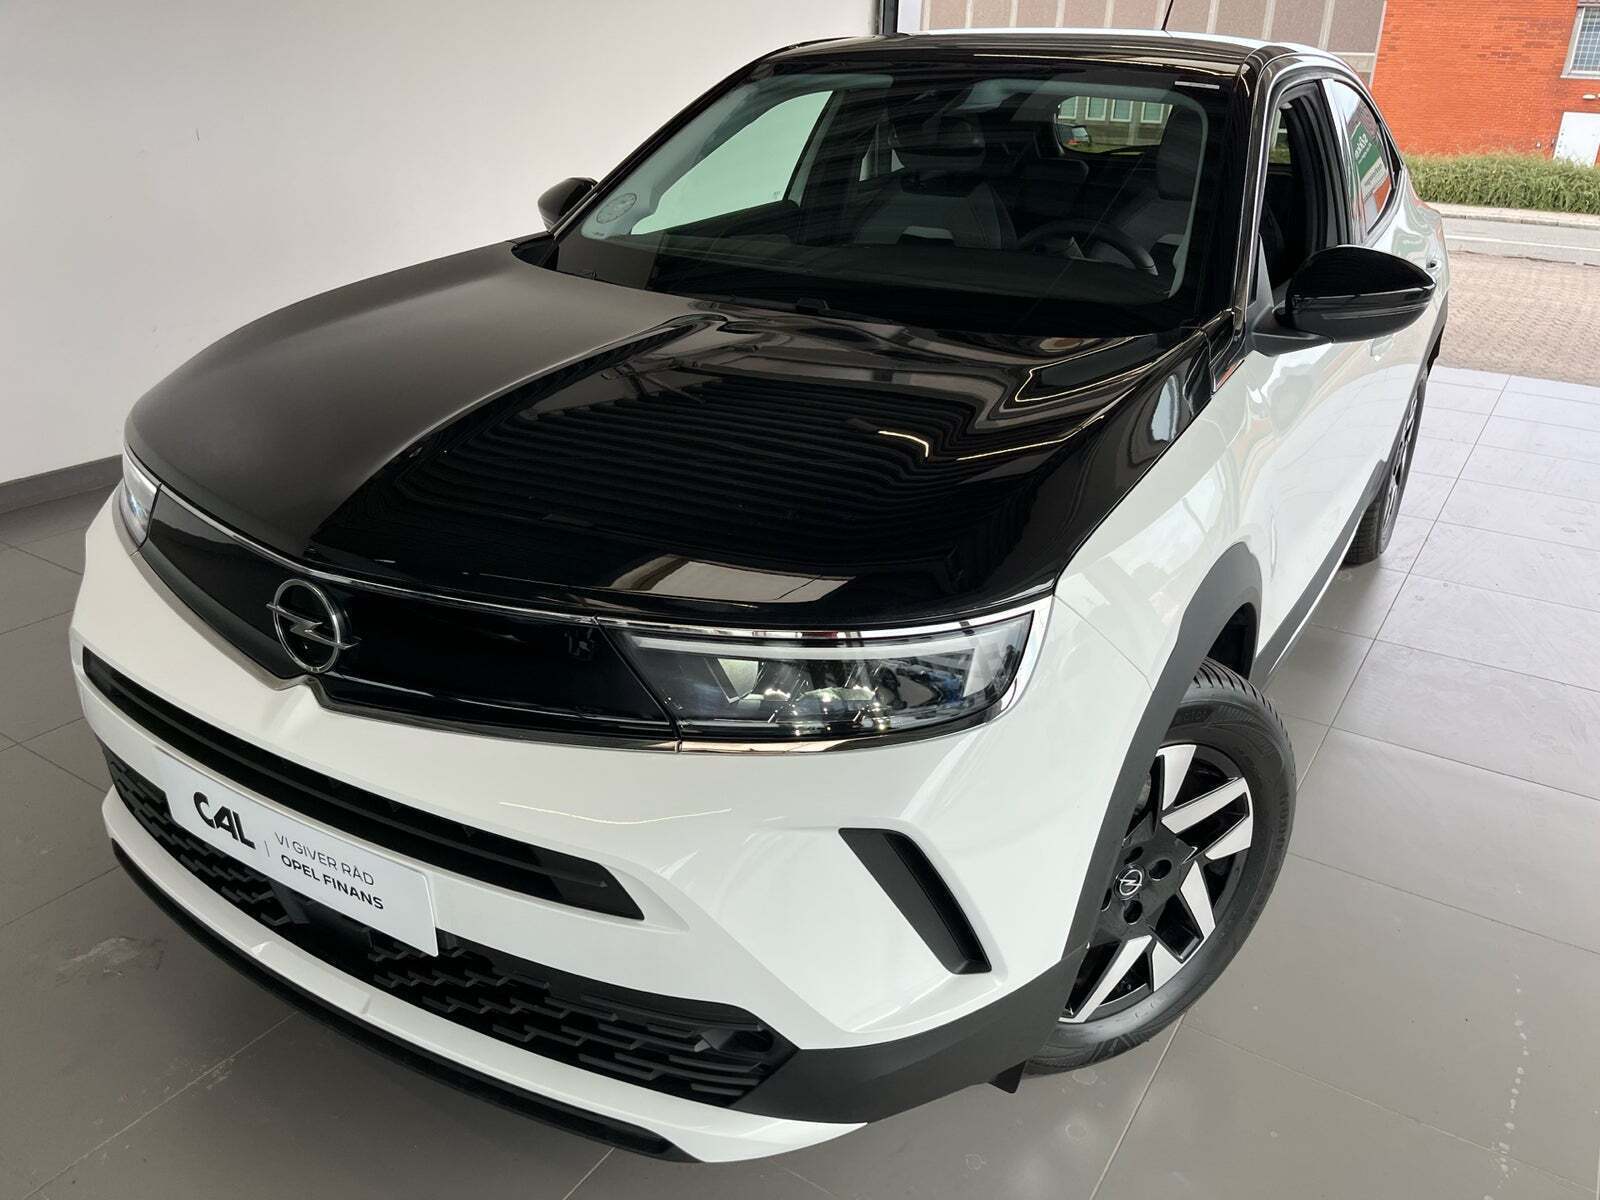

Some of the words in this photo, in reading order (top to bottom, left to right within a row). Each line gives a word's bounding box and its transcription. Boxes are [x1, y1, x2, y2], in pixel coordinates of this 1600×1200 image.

[193, 791, 256, 850] CAL
[275, 831, 290, 848] VI
[292, 841, 337, 870] GIVER
[281, 854, 320, 881] OPEL
[322, 873, 383, 909] FINANS
